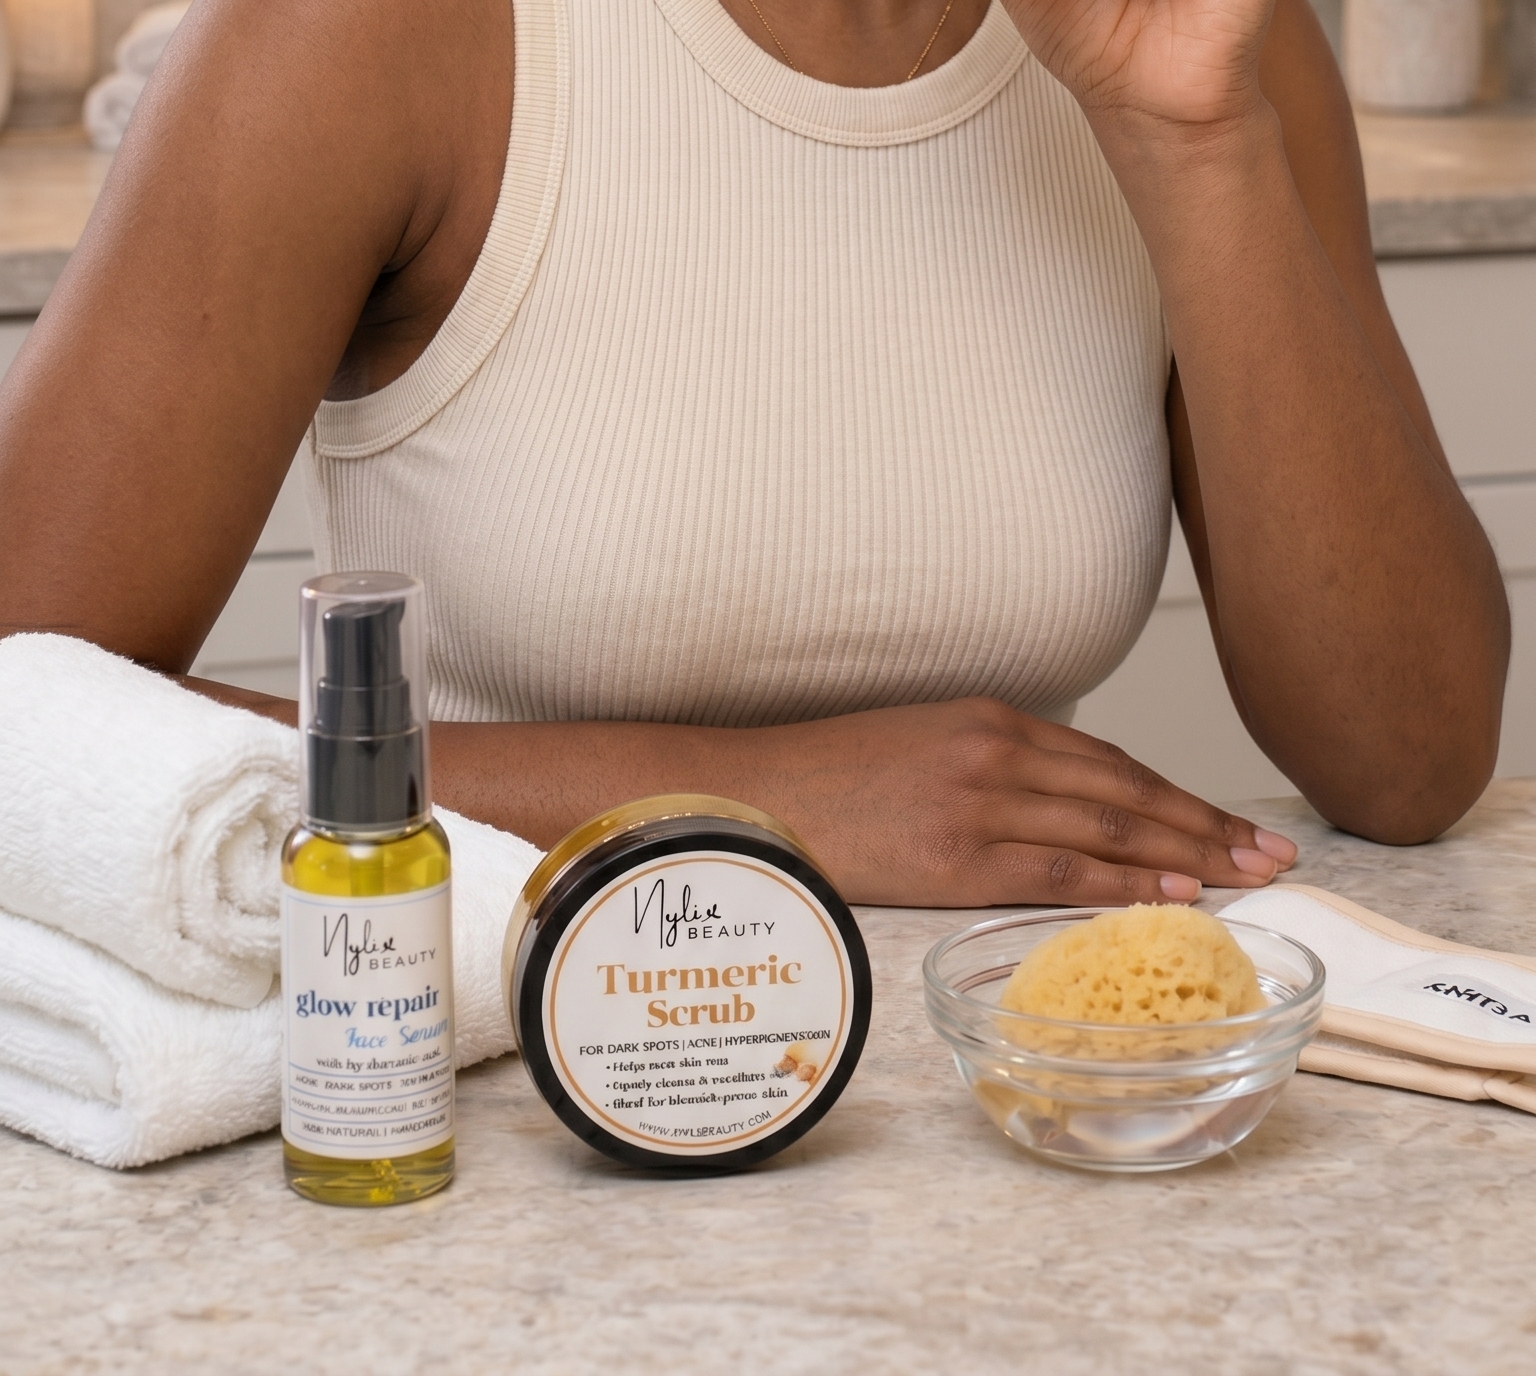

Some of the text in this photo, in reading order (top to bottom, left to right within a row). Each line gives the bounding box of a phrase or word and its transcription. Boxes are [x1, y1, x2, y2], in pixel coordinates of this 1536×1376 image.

[688, 921, 776, 940] BEAUTY
[368, 947, 437, 971] BEAUTY
[596, 954, 803, 996] Turmeric
[296, 984, 440, 1022] glow repair
[647, 993, 756, 1029] Scrub
[579, 1044, 604, 1056] FOR
[608, 1041, 640, 1055] DARK
[643, 1039, 680, 1053] SPOTS
[687, 1037, 718, 1049] ACNE
[679, 1056, 702, 1068] skin
